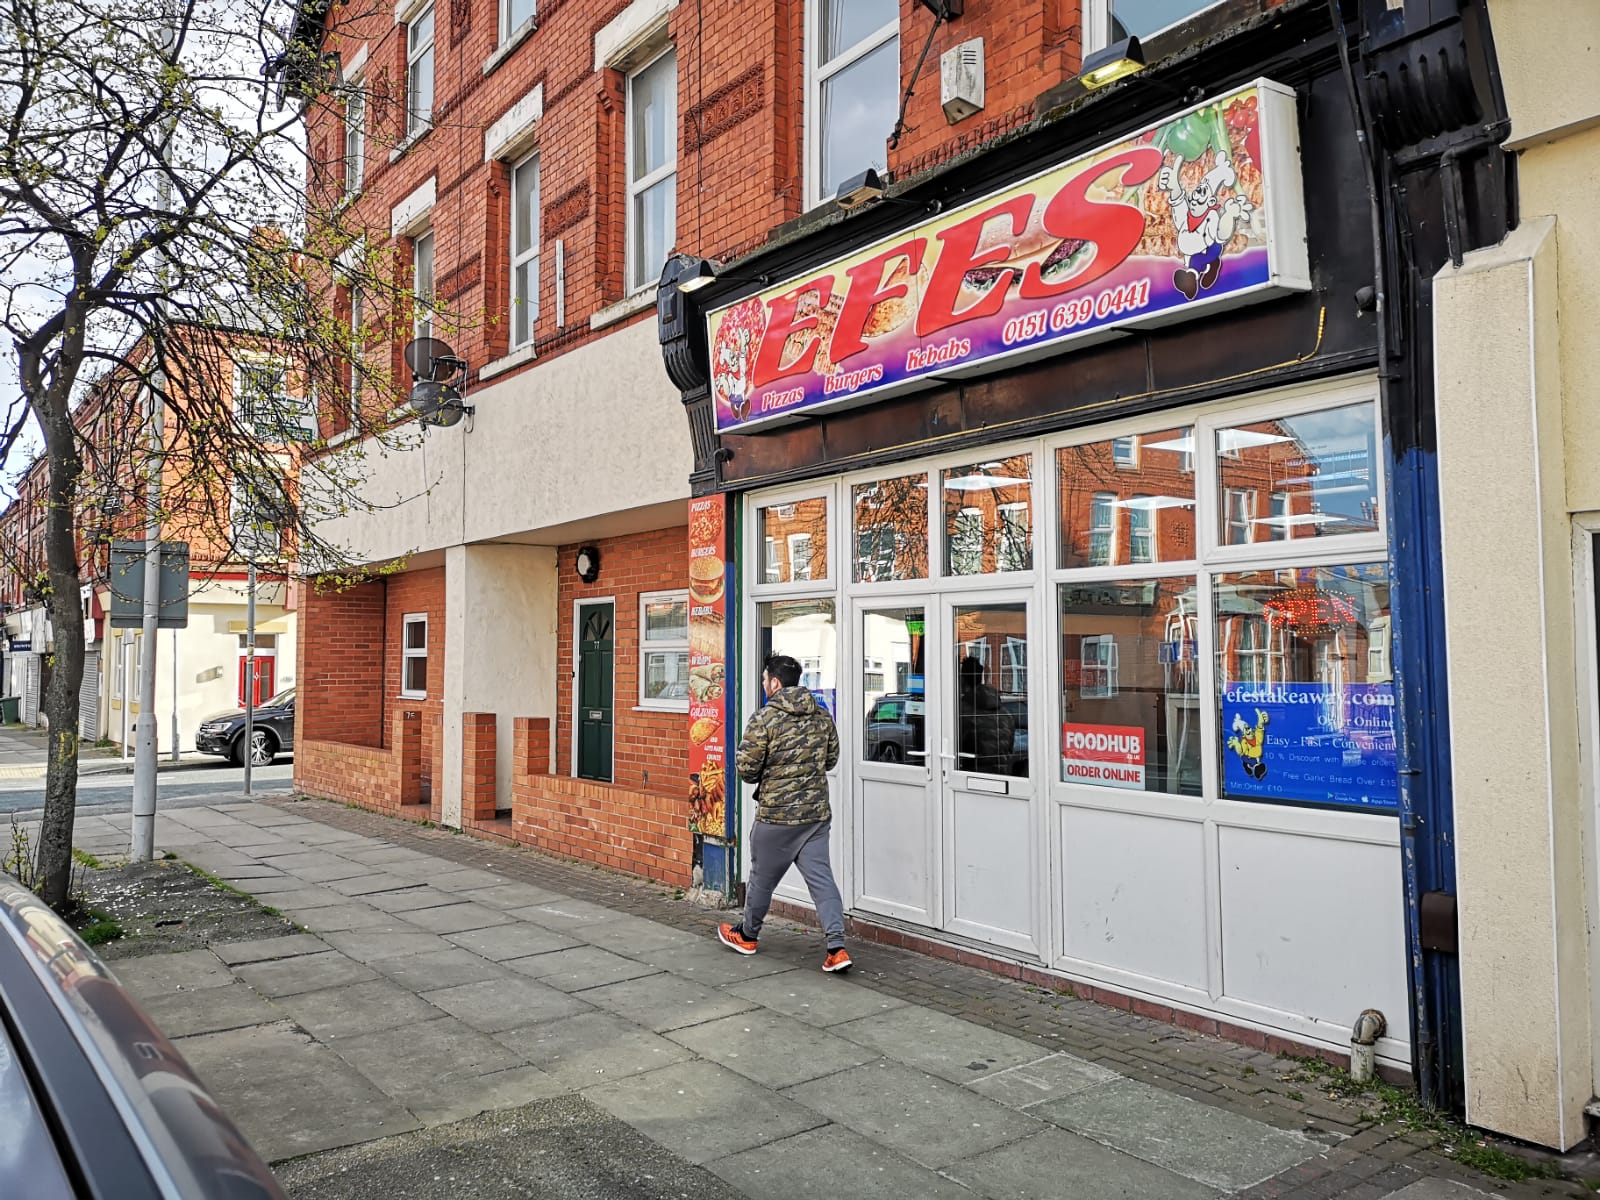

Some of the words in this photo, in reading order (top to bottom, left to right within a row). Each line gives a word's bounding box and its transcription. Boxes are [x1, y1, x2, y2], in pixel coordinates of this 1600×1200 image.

[752, 147, 1164, 387] EFES
[1003, 309, 1047, 343] 0151
[1051, 299, 1092, 331] 639
[1096, 280, 1149, 318] 0441
[762, 387, 804, 411] Pizzas
[824, 365, 883, 395] Burgers
[906, 338, 970, 371] Kebabs
[1264, 597, 1356, 624] OPEN
[1066, 731, 1141, 754] FOODHUB
[1266, 735, 1289, 749] Easy
[1301, 736, 1321, 747] Fast
[1332, 736, 1396, 751] Convenient
[1289, 753, 1320, 762] Discount
[1067, 764, 1101, 779] ORDER
[1103, 767, 1141, 783] ONLINE
